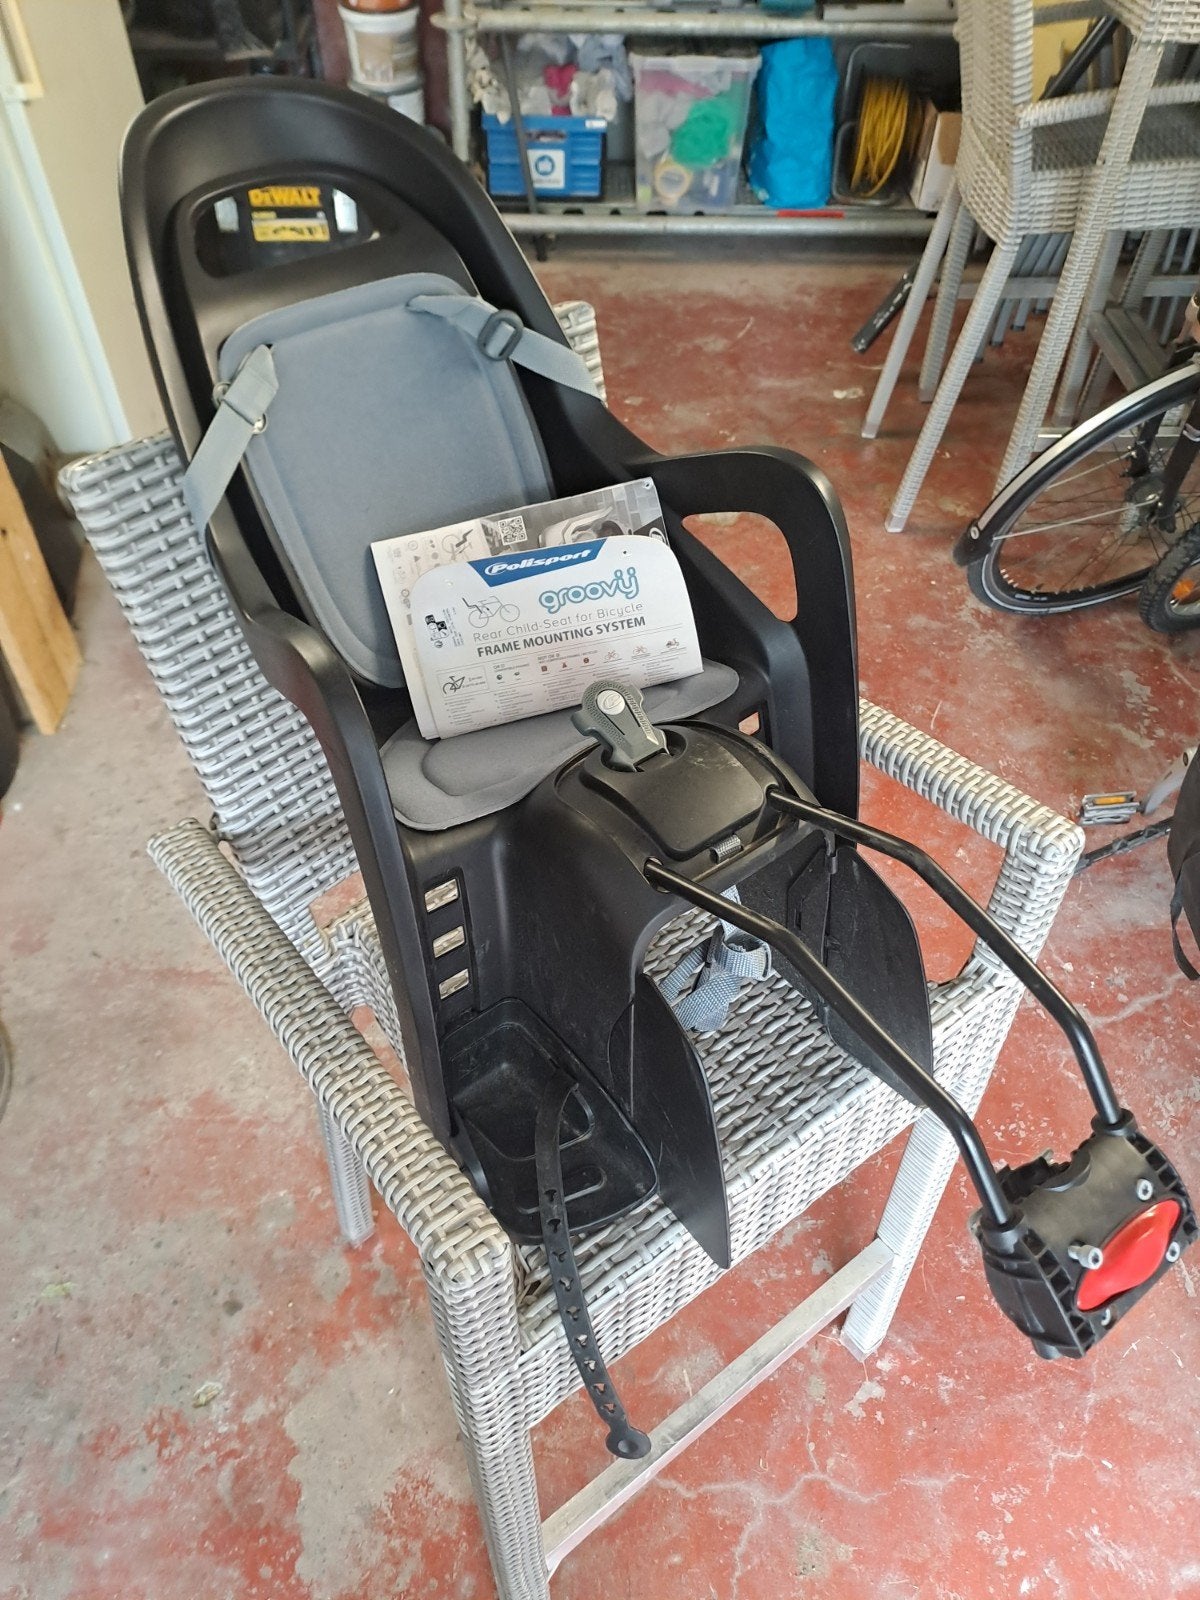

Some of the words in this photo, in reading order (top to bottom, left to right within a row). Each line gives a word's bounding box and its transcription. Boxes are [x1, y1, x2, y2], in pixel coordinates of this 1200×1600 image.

[484, 549, 592, 576] Polisport
[473, 629, 502, 642] Rear
[506, 614, 573, 637] Child-Seat
[576, 611, 593, 623] for
[597, 602, 644, 620] Bicycle
[477, 640, 521, 658] FRAME
[523, 626, 594, 649] MOUNTING
[596, 616, 647, 635] SYSTEM
